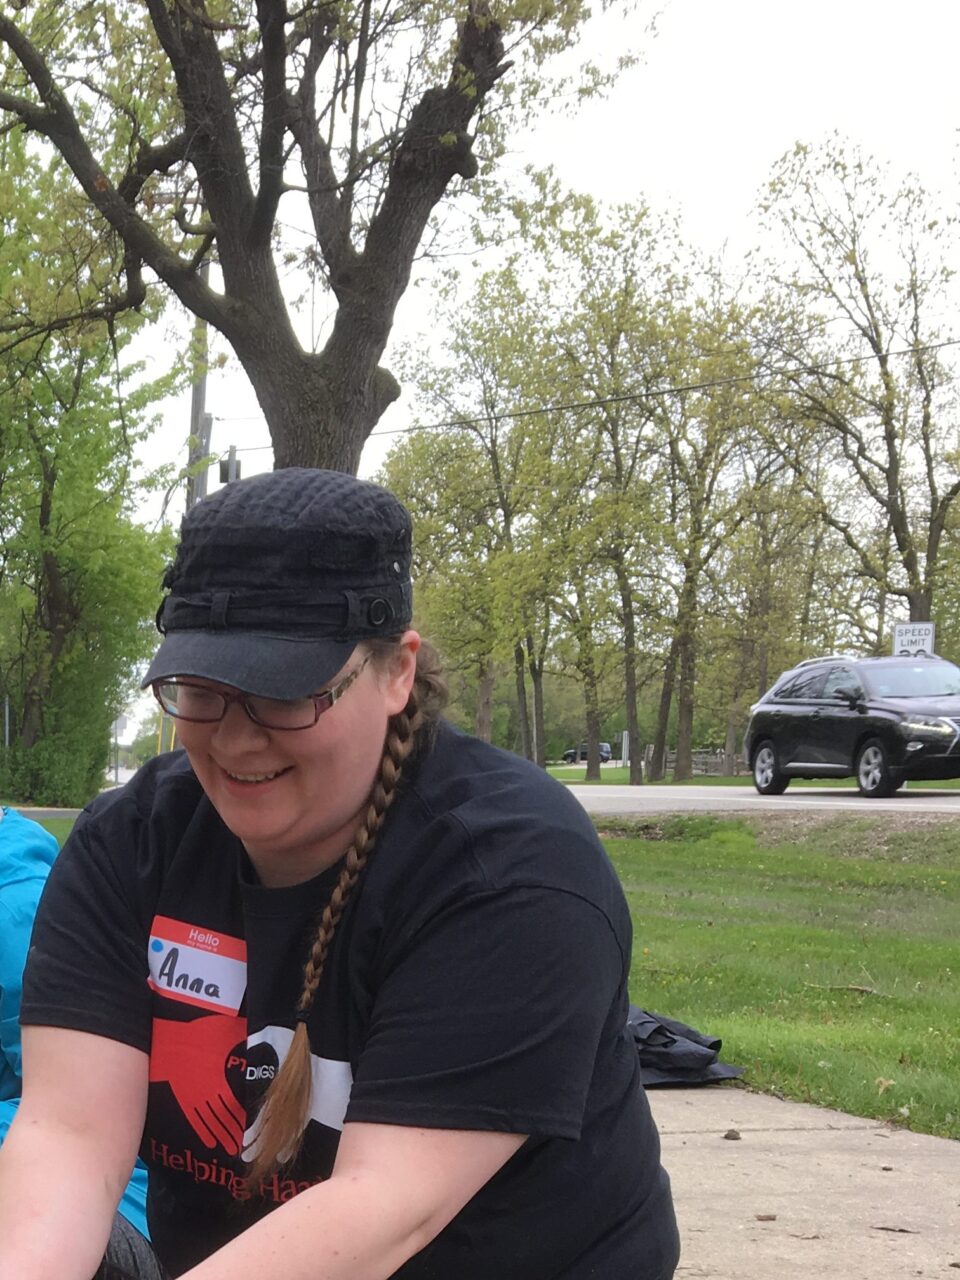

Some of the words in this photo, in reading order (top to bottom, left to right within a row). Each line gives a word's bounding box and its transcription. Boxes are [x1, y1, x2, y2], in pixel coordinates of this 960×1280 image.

[897, 628, 931, 637] SPEED
[900, 639, 927, 647] LIMIT
[189, 929, 220, 946] Hello
[159, 947, 220, 998] Anna
[151, 1138, 252, 1200] Helping
